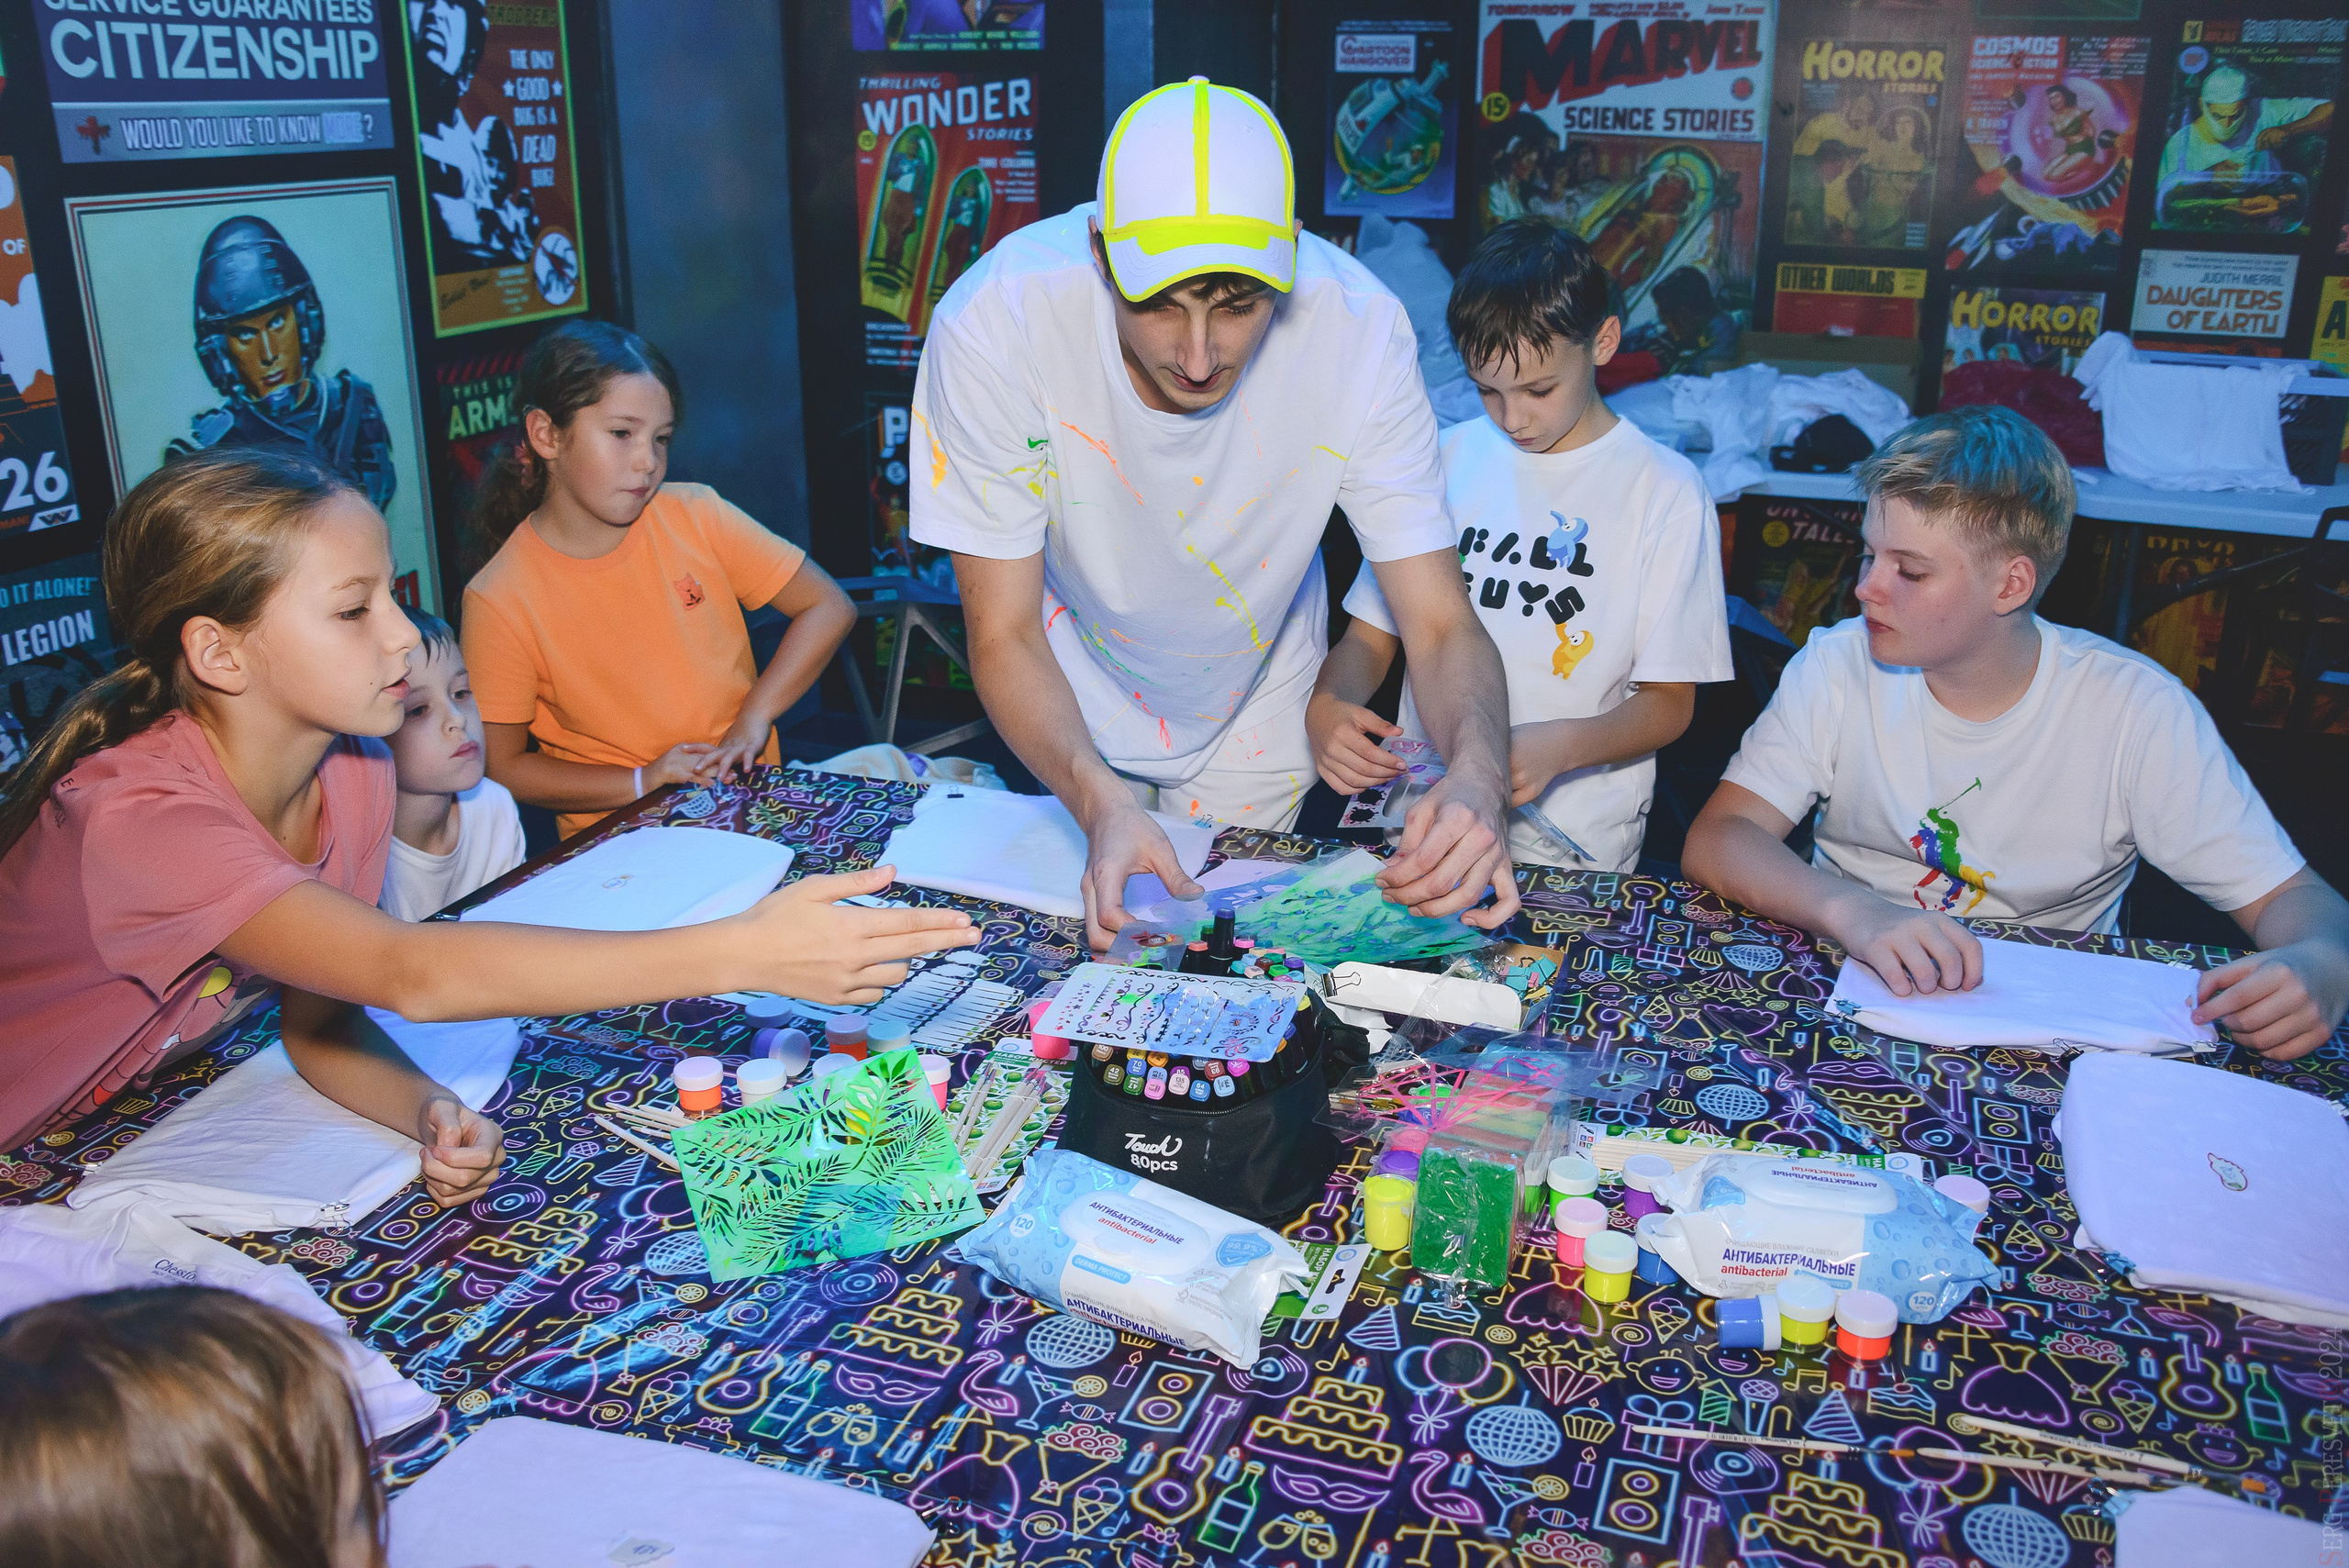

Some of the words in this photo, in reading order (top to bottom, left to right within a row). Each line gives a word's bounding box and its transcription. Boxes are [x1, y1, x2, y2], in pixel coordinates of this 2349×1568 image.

[50, 18, 379, 81] CITIZENSHIP
[1974, 36, 2060, 56] COSMOS
[1483, 18, 1763, 111] MARVEL
[1802, 40, 1944, 81] HORROR
[858, 76, 942, 90] THRILLING
[861, 77, 1032, 136] WONDER
[1564, 106, 1655, 130] SCIENCE
[1662, 107, 1754, 132] STORIES
[119, 117, 184, 150] WOULD
[184, 117, 220, 147] YOU
[221, 117, 255, 147] LIKE
[255, 116, 277, 145] TO
[277, 115, 322, 143] KNOW
[966, 128, 1034, 140] STORIES
[2, 238, 27, 256] OF
[2199, 272, 2241, 285] JUDITH
[2146, 284, 2284, 311] DAUGHTERS
[1951, 291, 2100, 336] HORROR
[2165, 310, 2200, 329] OF
[2201, 311, 2279, 334] EARTH
[12, 583, 29, 606] IT
[1, 609, 96, 667] LEGION
[994, 1051, 1028, 1061] НАБОР
[1130, 1153, 1178, 1173] 80pcs
[1791, 1165, 1856, 1178] antibacterial
[1771, 1169, 1878, 1188] АНТИБАКТЕРИАЛЬНЫЕ
[1014, 1216, 1034, 1230] 120
[1089, 1200, 1186, 1245] АНТИБАКТЕРИАЛЬНЫЕ
[1097, 1216, 1159, 1246] antibacterial
[1074, 1256, 1098, 1273] DERMA
[1097, 1265, 1129, 1282] PROTECT
[1316, 1247, 1333, 1272] НАБОР
[1720, 1264, 1788, 1277] antibacterial
[1722, 1248, 1856, 1276] АНТИБАКТЕРИАЛЬНЫЕ
[1913, 1296, 1935, 1306] 120
[1067, 1298, 1186, 1347] АНТИБАКТЕРИАЛЬНЫЕ
